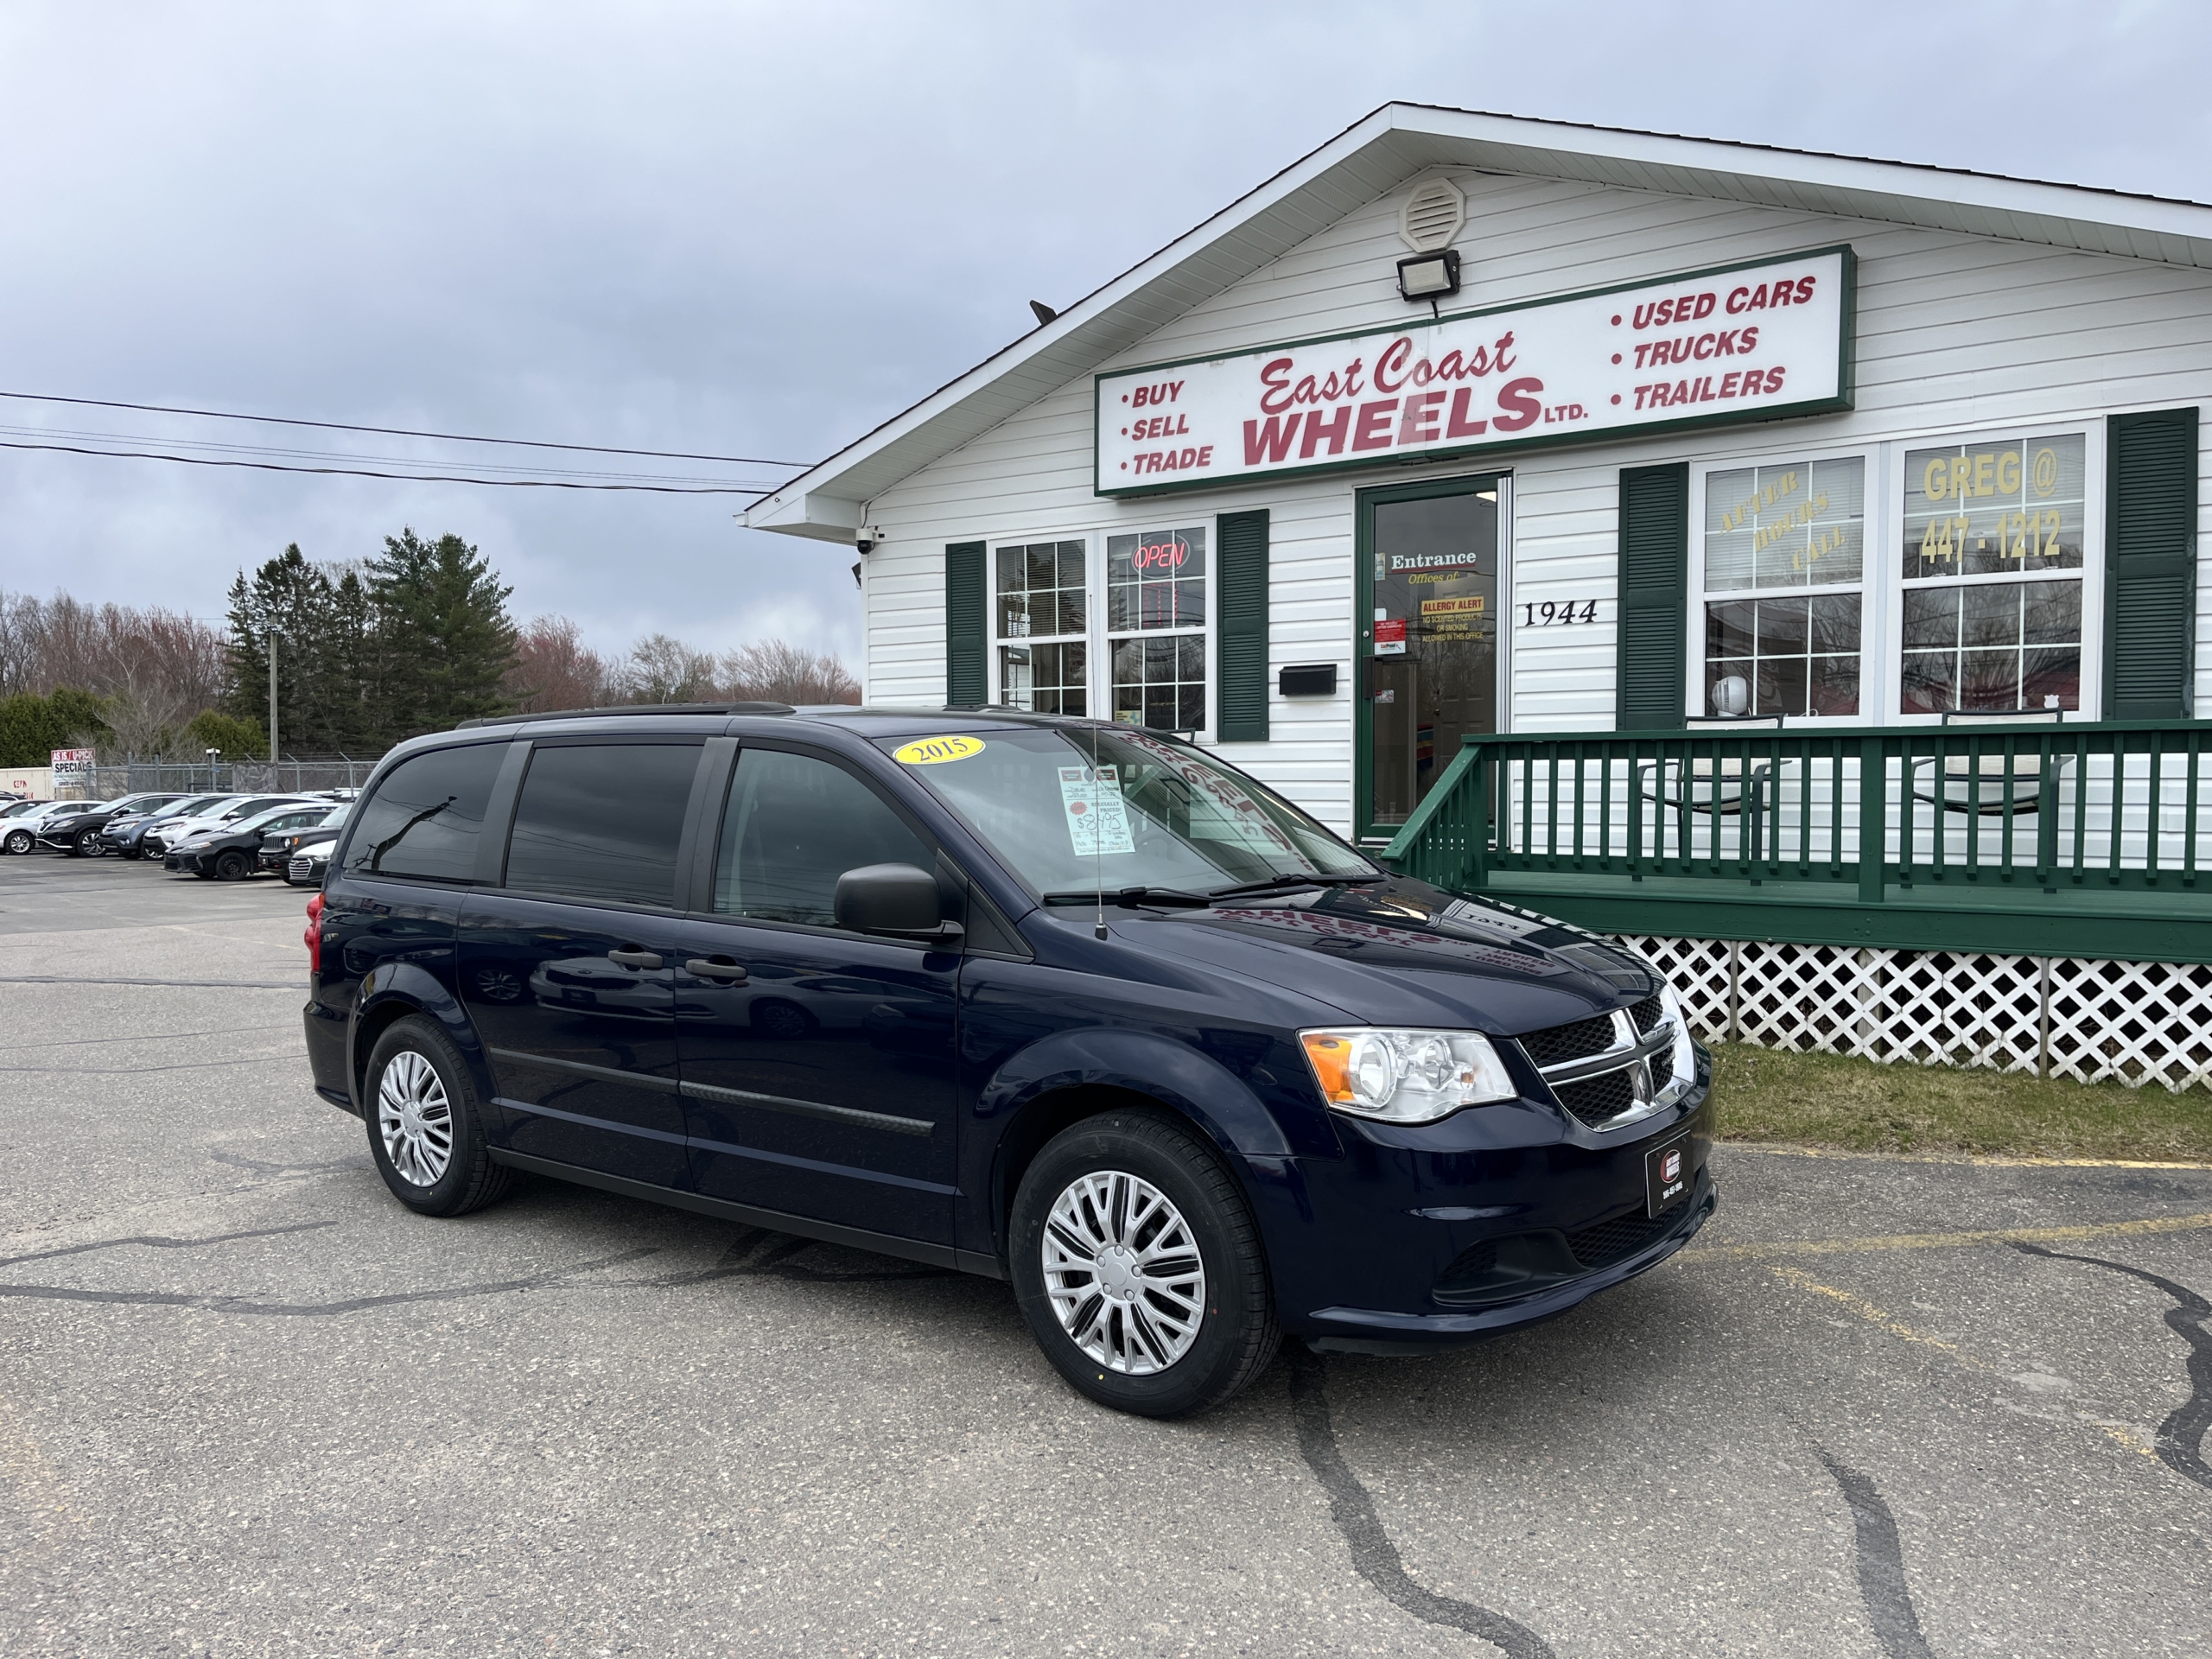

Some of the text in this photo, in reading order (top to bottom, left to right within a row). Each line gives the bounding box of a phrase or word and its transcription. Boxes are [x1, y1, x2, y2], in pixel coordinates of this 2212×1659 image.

[1632, 276, 1816, 330] USED CARS
[1634, 327, 1759, 370] TRUCKS
[1260, 330, 1517, 415] East Coast
[1132, 380, 1185, 408] BUY
[1634, 366, 1786, 410] TRAILERS
[1132, 413, 1190, 441] SELL
[1243, 377, 1589, 466] WHEELS LTD.
[1133, 445, 1214, 475] TRADE
[1924, 448, 2058, 501] GREG @
[1719, 470, 1799, 535] AFTER
[1752, 491, 1828, 553] HOURS
[1135, 542, 1185, 569] OPEN
[1391, 552, 1477, 570] Entrance
[1792, 525, 1845, 571] CALL
[1408, 572, 1444, 585] Offices
[1422, 613, 1483, 624] NO SCENTED PRODUCTS
[1423, 599, 1483, 613] ALLERGY ALERT
[1525, 600, 1598, 627] 1944
[1422, 634, 1446, 643] ALLOWED
[1453, 632, 1465, 641] THIS
[1465, 631, 1484, 640] OFFICE
[1446, 623, 1469, 632] SMOKING
[53, 752, 61, 761] AS
[62, 751, 67, 760] IS
[72, 750, 93, 760] U-PICK
[912, 738, 969, 761] 2015
